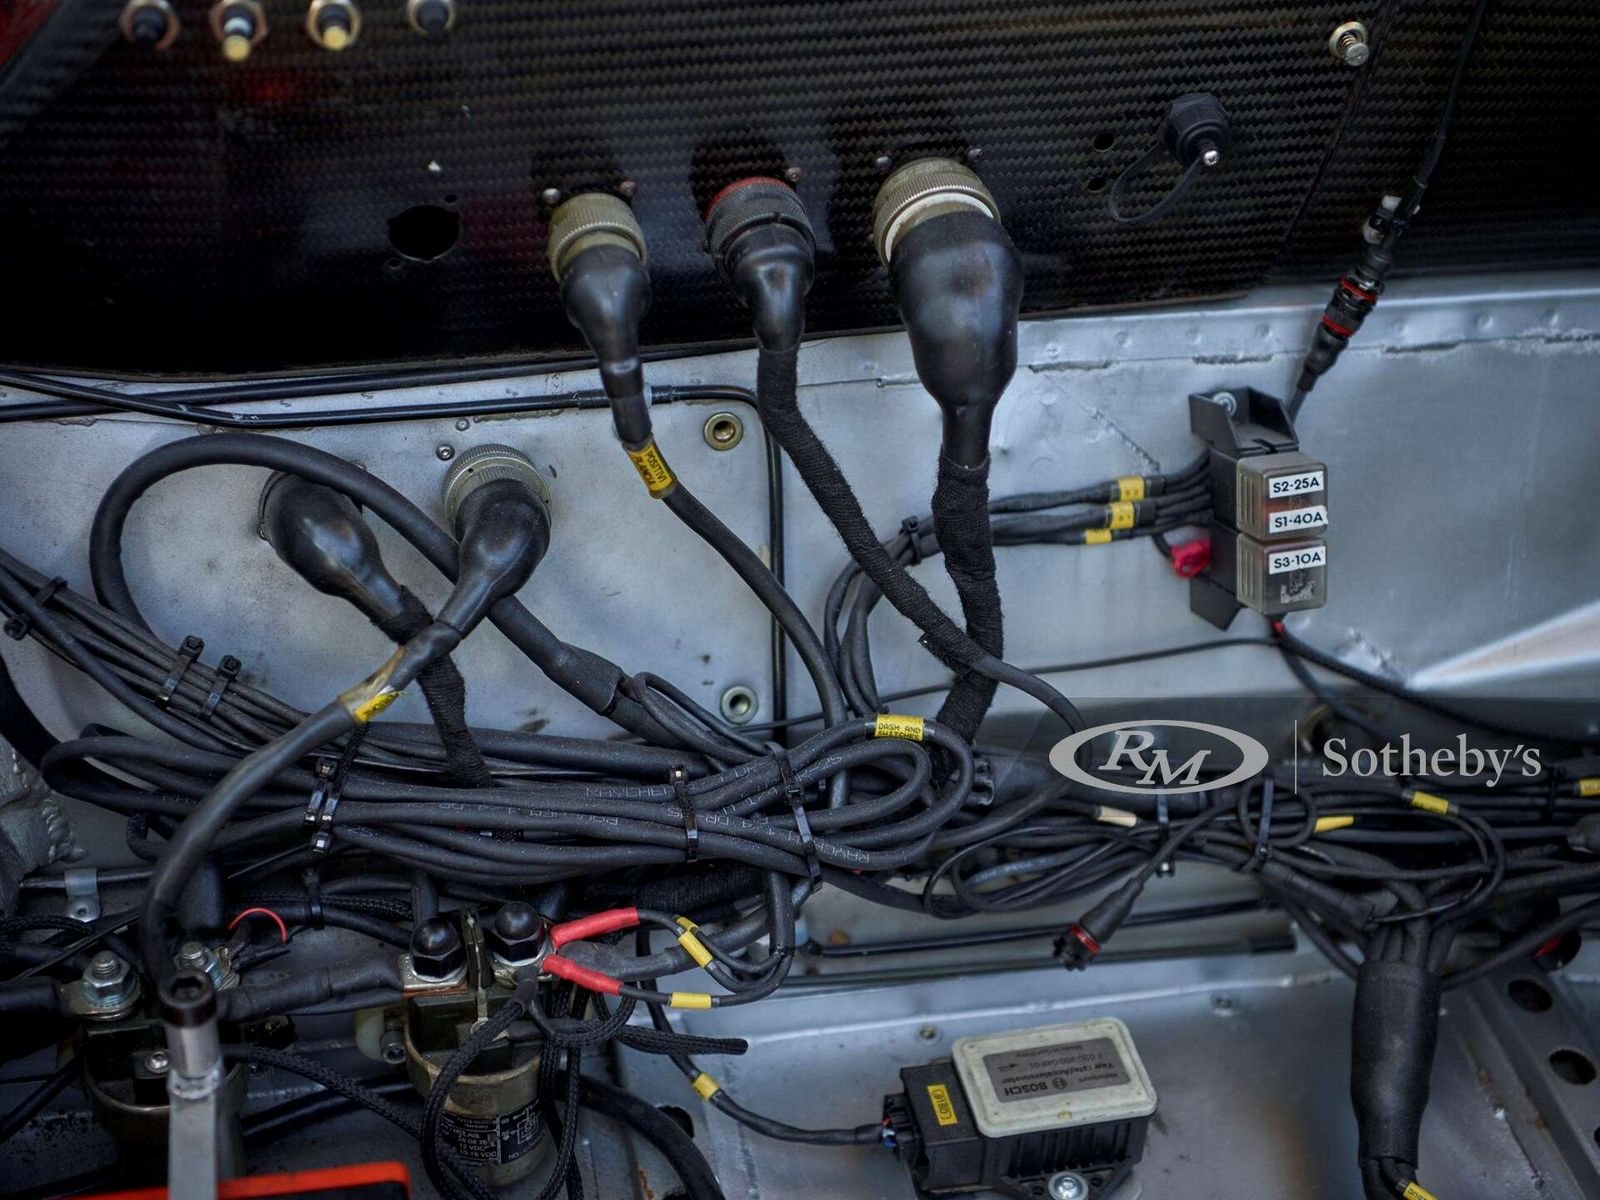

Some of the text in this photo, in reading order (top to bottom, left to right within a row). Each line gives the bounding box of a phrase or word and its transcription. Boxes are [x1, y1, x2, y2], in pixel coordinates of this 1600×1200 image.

[1273, 477, 1320, 493] S2-25A
[1274, 511, 1323, 528] S1-40A
[1274, 552, 1321, 569] S3-10A
[1005, 1082, 1047, 1095] BOSCH
